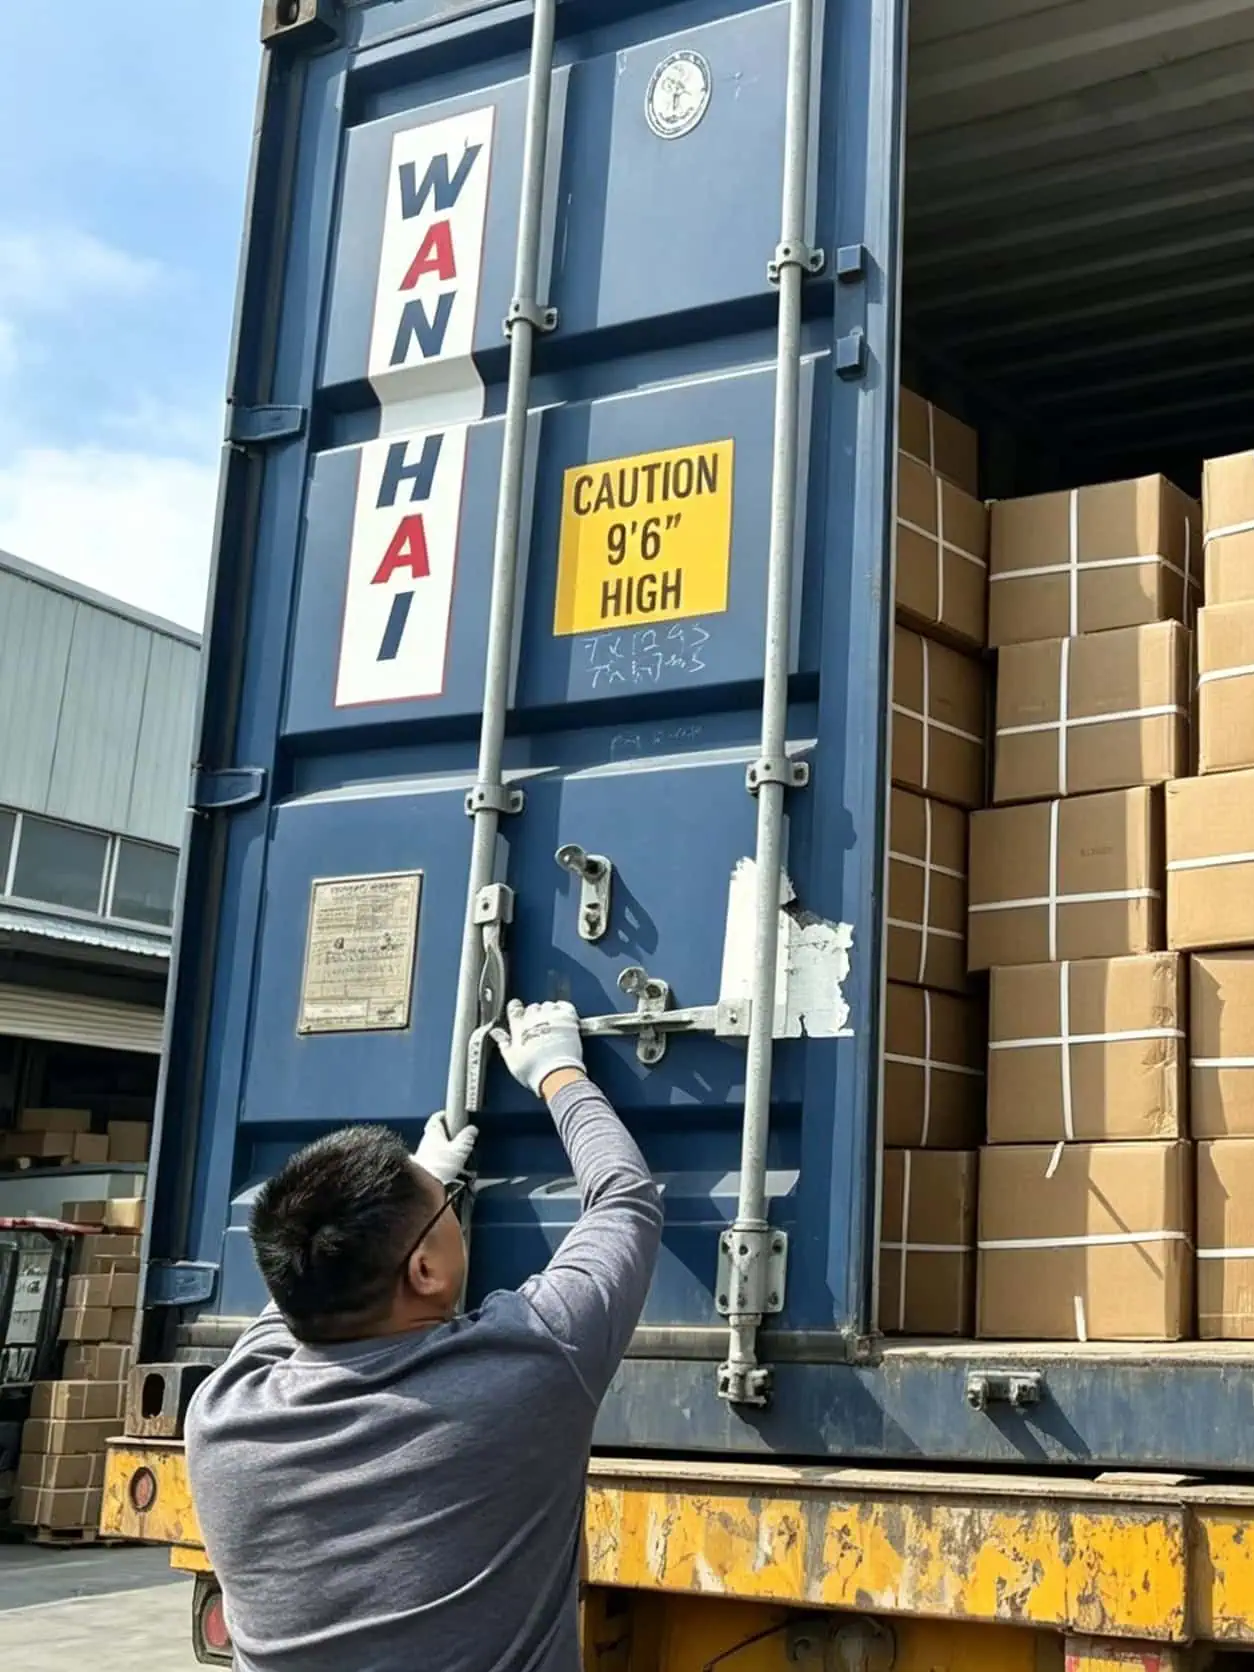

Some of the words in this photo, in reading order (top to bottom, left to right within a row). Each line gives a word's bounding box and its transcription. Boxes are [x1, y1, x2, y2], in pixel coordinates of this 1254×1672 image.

[388, 143, 482, 367] WAN
[369, 433, 443, 663] HAI
[573, 453, 719, 517] CAUTION
[600, 567, 683, 619] HIGH
